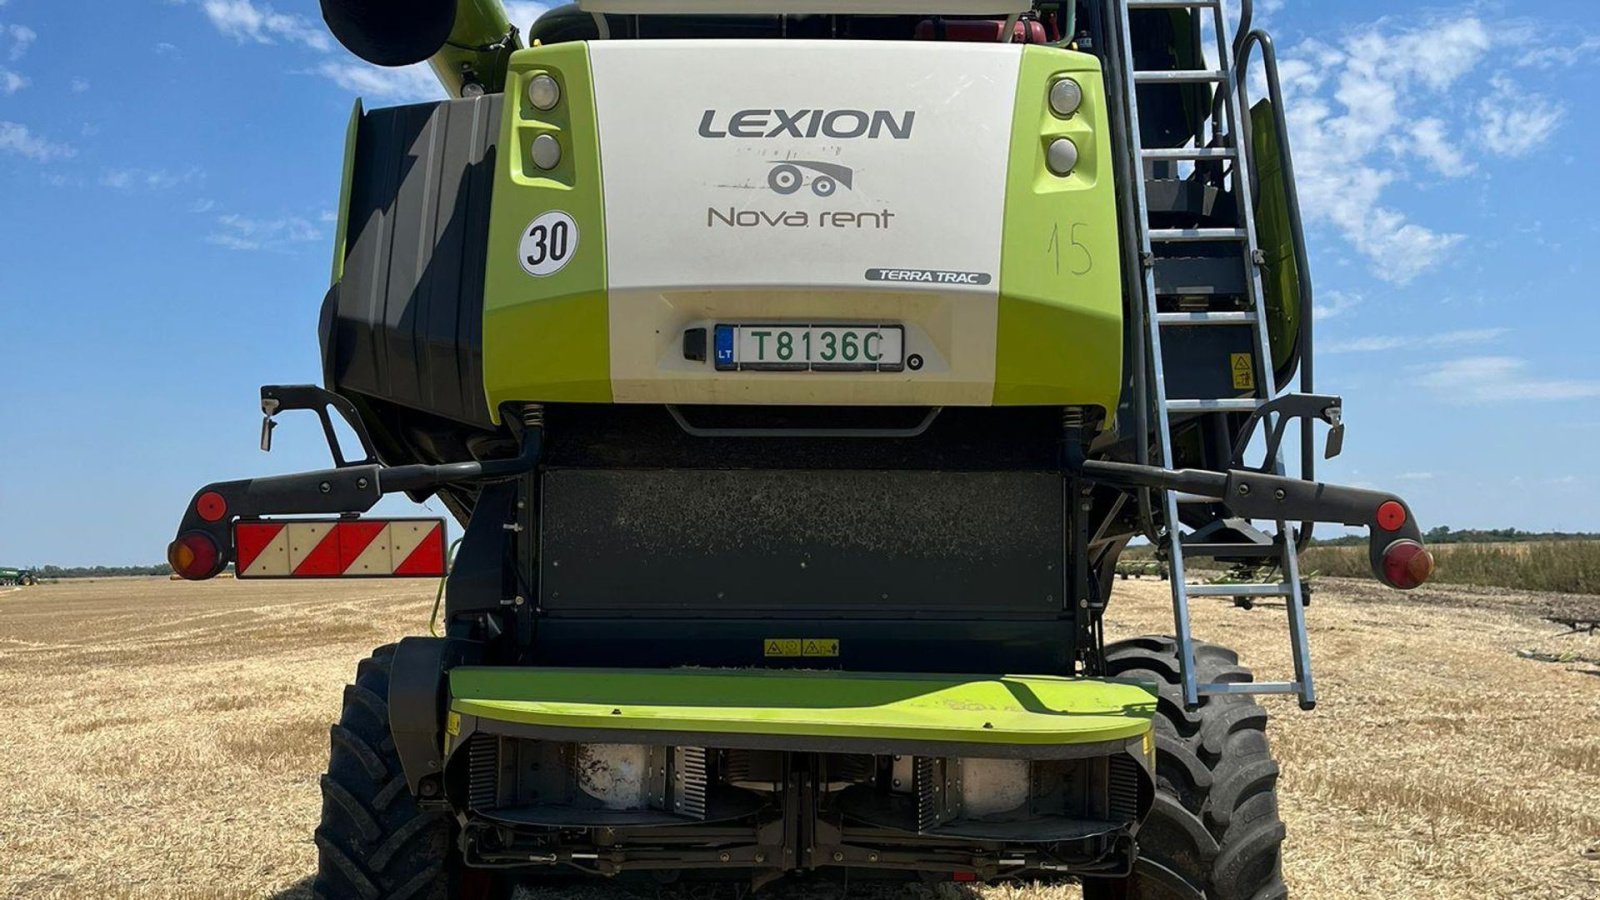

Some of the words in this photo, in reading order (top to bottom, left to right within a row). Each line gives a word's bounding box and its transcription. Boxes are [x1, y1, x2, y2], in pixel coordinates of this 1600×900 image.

[698, 109, 916, 139] LEXION
[707, 207, 809, 228] Nova
[819, 209, 895, 229] rent
[527, 220, 568, 266] 30
[1047, 222, 1092, 276] 15
[879, 269, 933, 282] TERRA
[936, 271, 979, 284] TRAC
[718, 350, 732, 359] LT
[751, 331, 884, 361] T8136C
